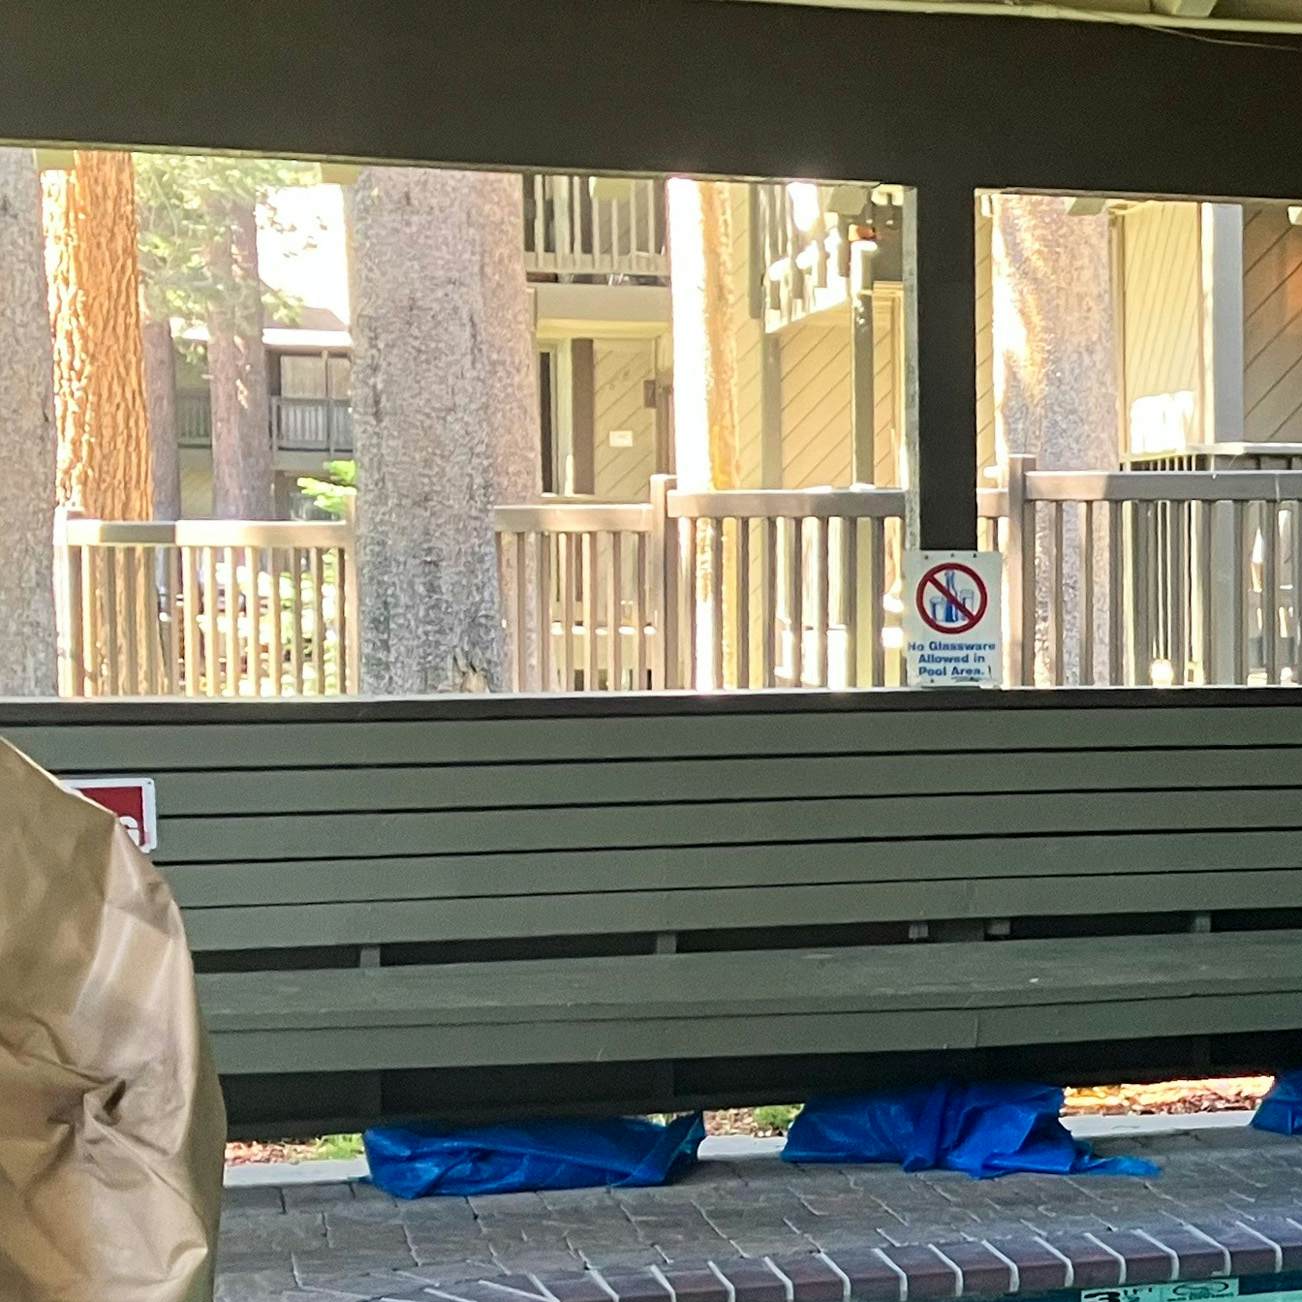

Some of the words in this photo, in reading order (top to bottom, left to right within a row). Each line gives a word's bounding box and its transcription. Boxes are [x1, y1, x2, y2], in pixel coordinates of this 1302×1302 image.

[929, 641, 996, 651] Glassware
[918, 654, 970, 664] Allowed
[974, 653, 986, 663] in
[918, 665, 947, 676] Pool
